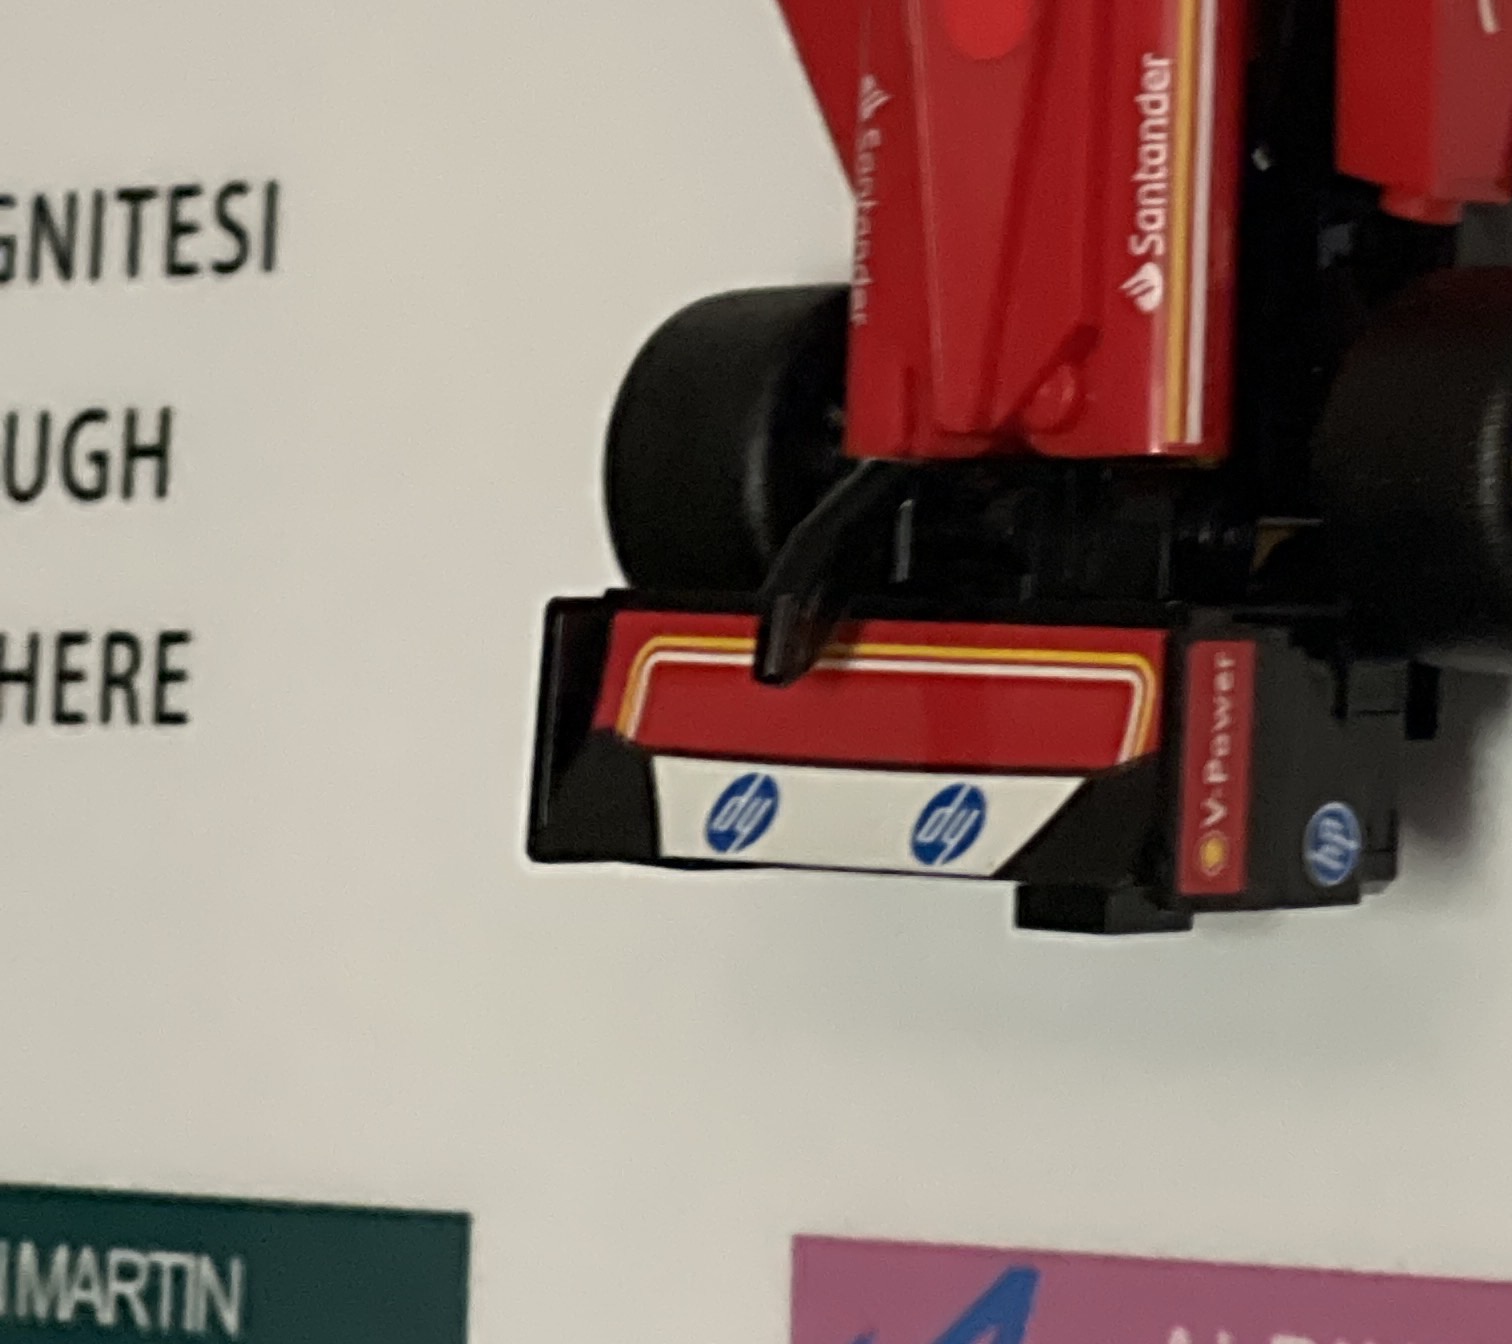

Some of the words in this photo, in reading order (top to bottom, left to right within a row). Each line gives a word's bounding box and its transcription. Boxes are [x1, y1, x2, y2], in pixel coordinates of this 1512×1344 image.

[1127, 51, 1172, 257] Santander
[1200, 650, 1236, 828] V-Power
[712, 773, 774, 854] hp
[915, 782, 982, 866] hp
[1306, 815, 1359, 873] hp
[14, 1239, 244, 1340] MARTIN
